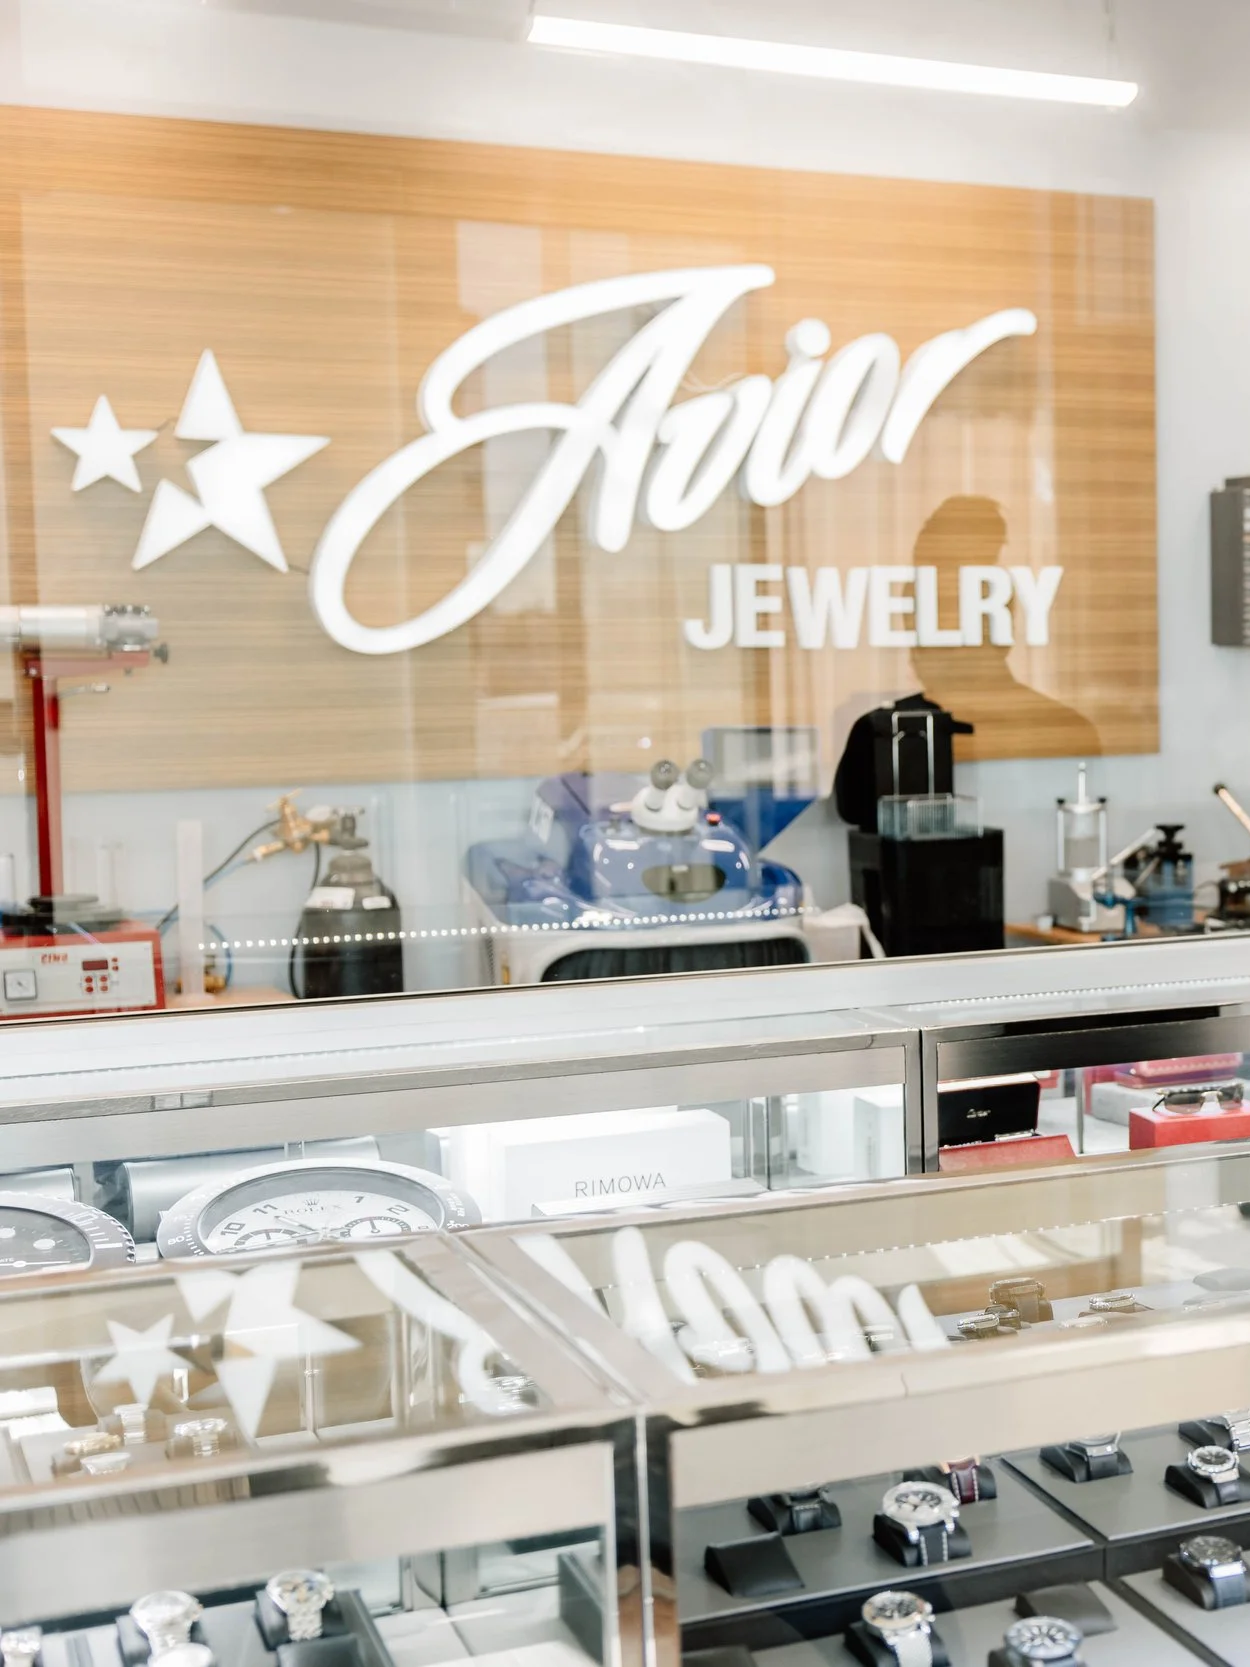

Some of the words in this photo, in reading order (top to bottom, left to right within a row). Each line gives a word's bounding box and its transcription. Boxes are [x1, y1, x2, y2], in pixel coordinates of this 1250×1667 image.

[307, 264, 1038, 655] Avior
[683, 563, 1064, 649] JEWELRY
[575, 1172, 667, 1198] RIMOWA
[284, 1204, 342, 1216] ROLEX
[220, 1222, 246, 1237] 10
